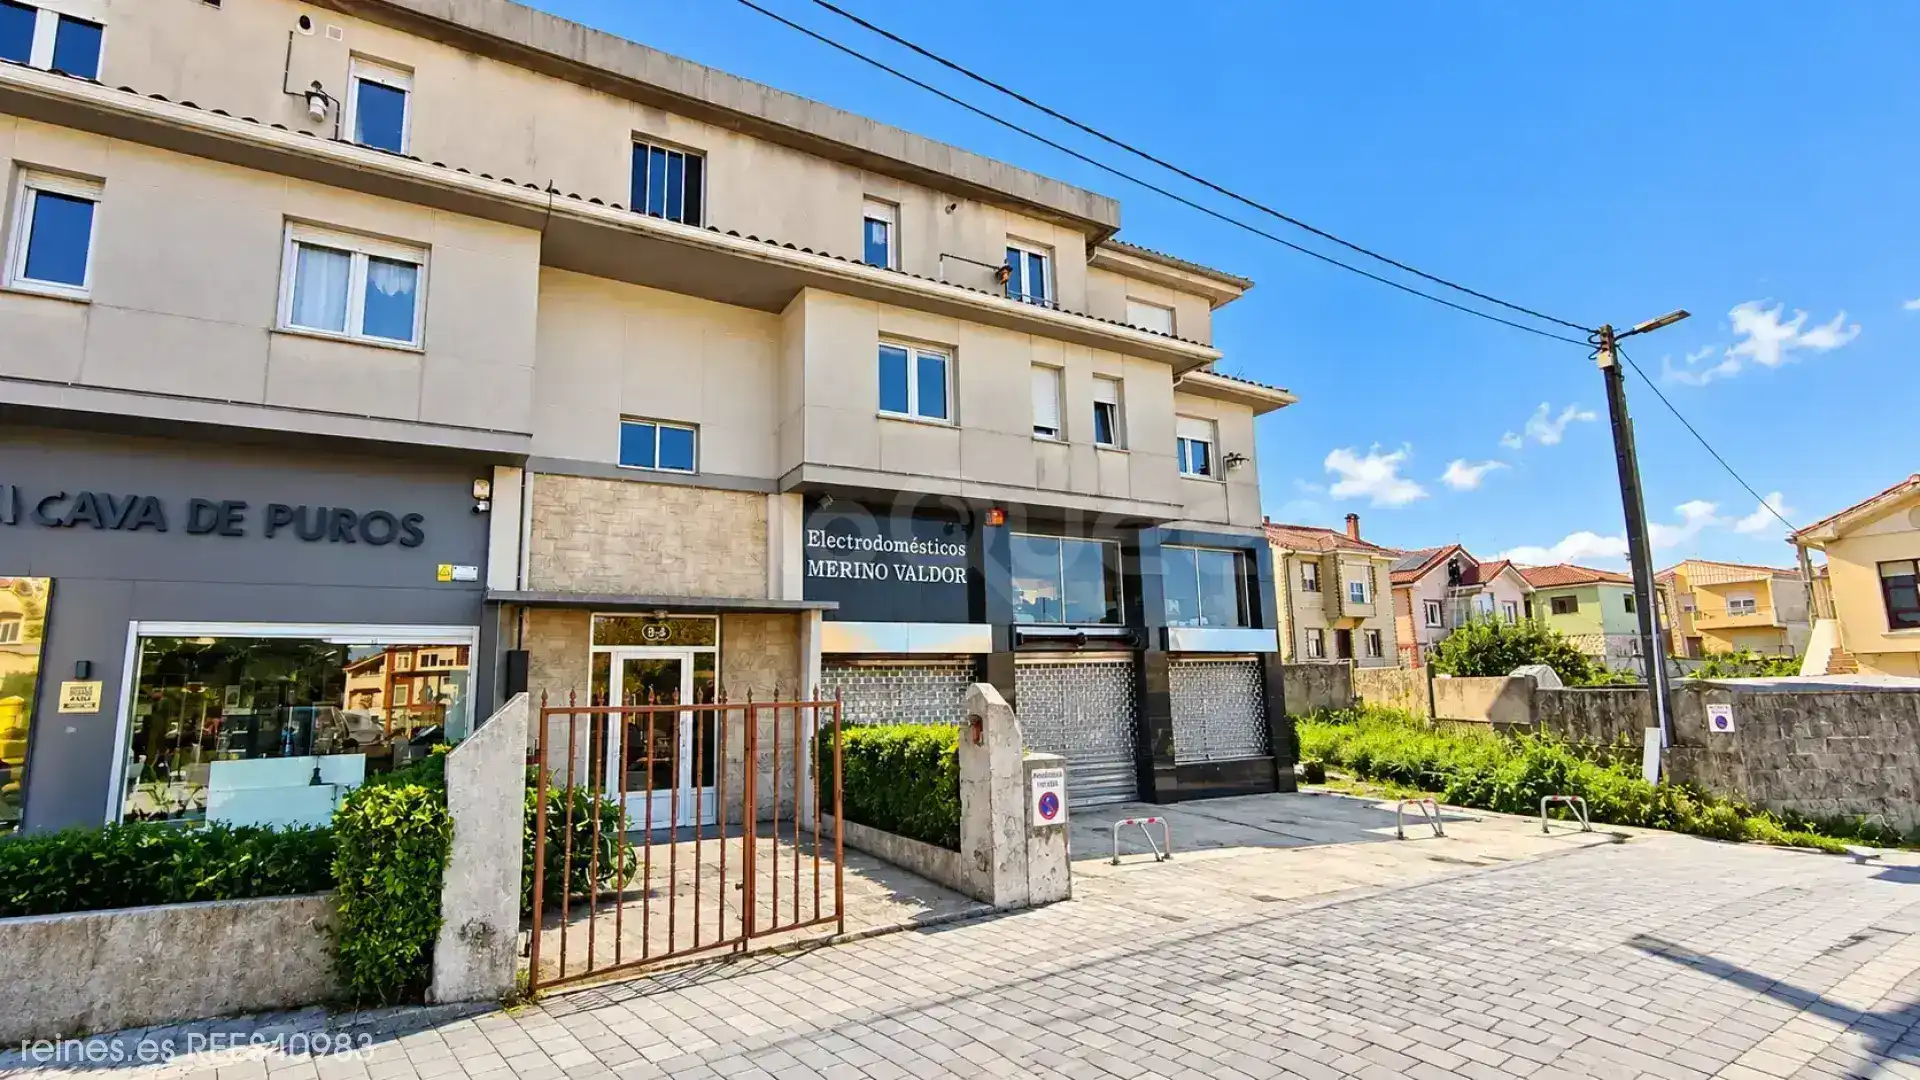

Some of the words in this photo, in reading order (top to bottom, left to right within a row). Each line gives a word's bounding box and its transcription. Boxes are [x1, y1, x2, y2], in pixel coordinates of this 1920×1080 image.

[32, 491, 167, 532] CAVA
[187, 498, 247, 536] DE
[264, 503, 424, 547] PUROS
[807, 529, 966, 557] Electrodomésticos
[808, 559, 889, 581] MERINO
[893, 564, 968, 584] VALDOR
